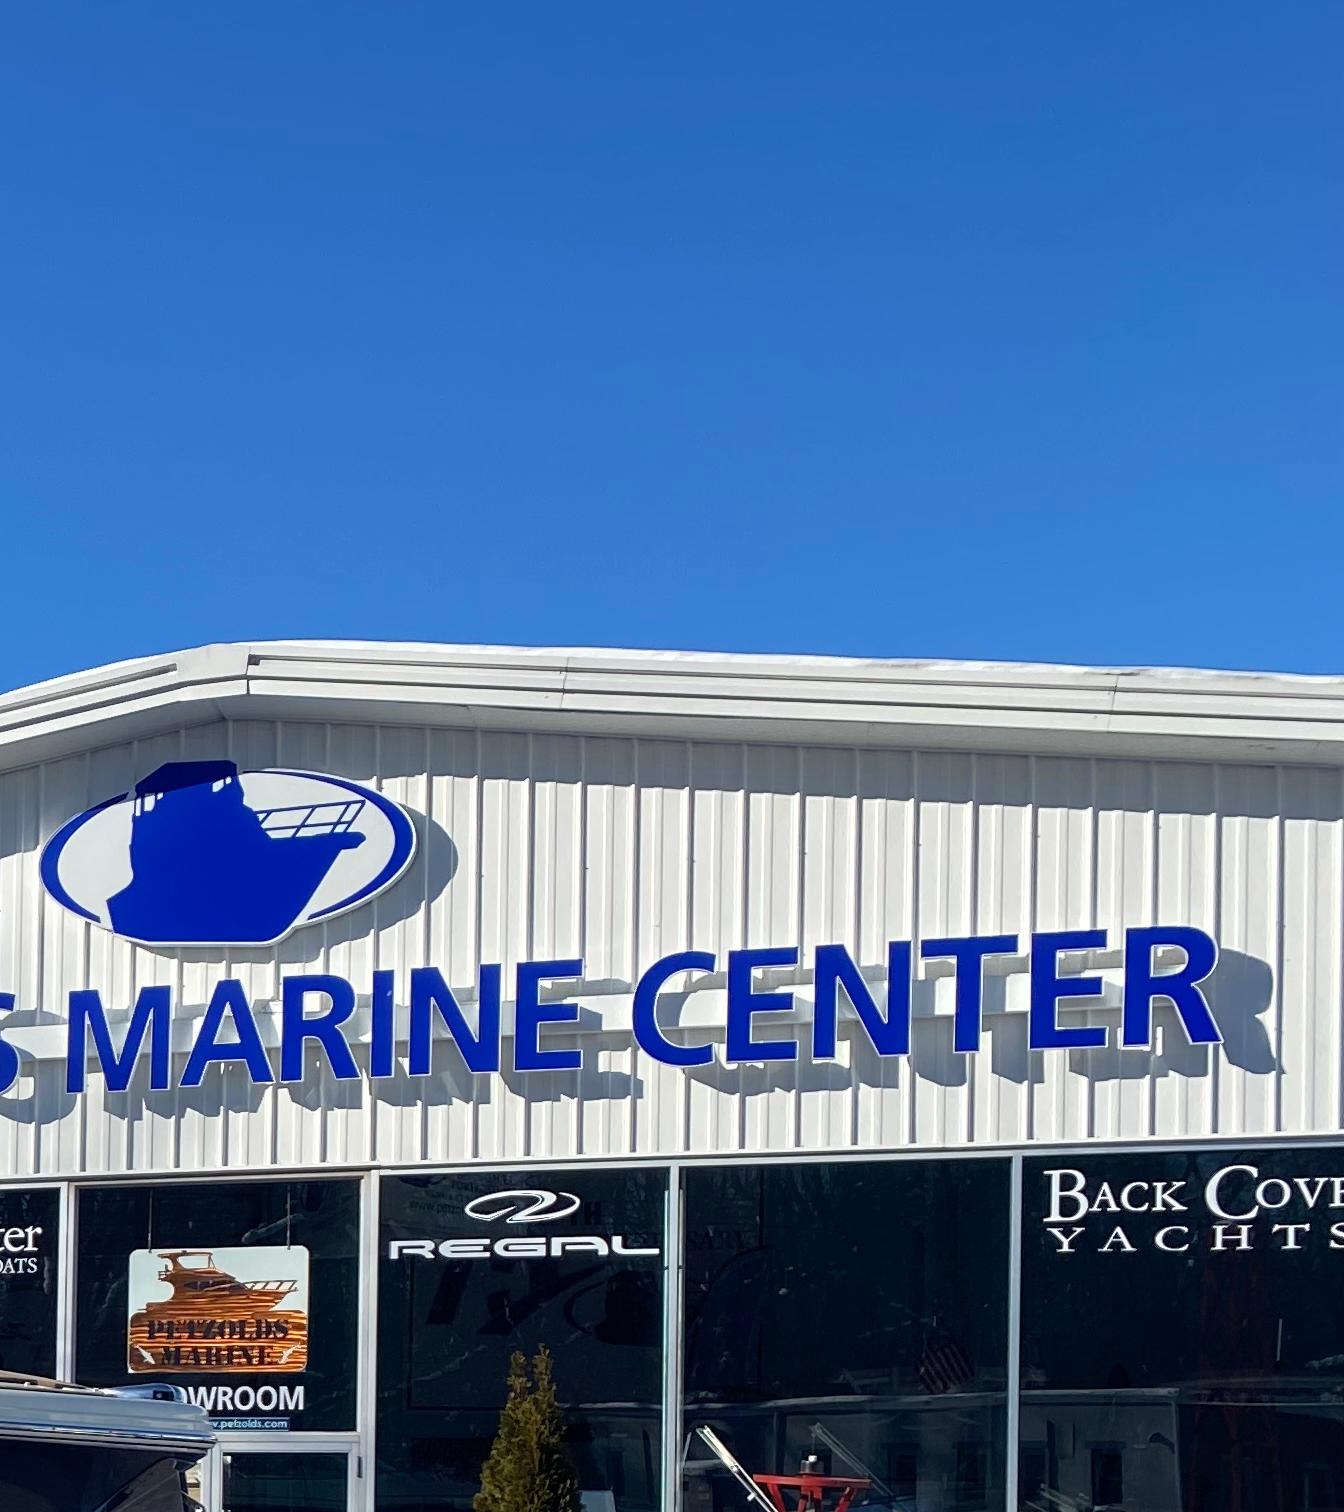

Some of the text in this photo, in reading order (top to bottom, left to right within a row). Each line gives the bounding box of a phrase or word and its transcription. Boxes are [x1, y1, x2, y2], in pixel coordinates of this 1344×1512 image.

[66, 958, 584, 1095] MARINE
[632, 925, 1224, 1068] CENTER
[1042, 1168, 1188, 1223] BACK
[388, 1234, 660, 1260] REGAL
[162, 1345, 274, 1366] MARINE
[179, 1385, 305, 1411] WROOM
